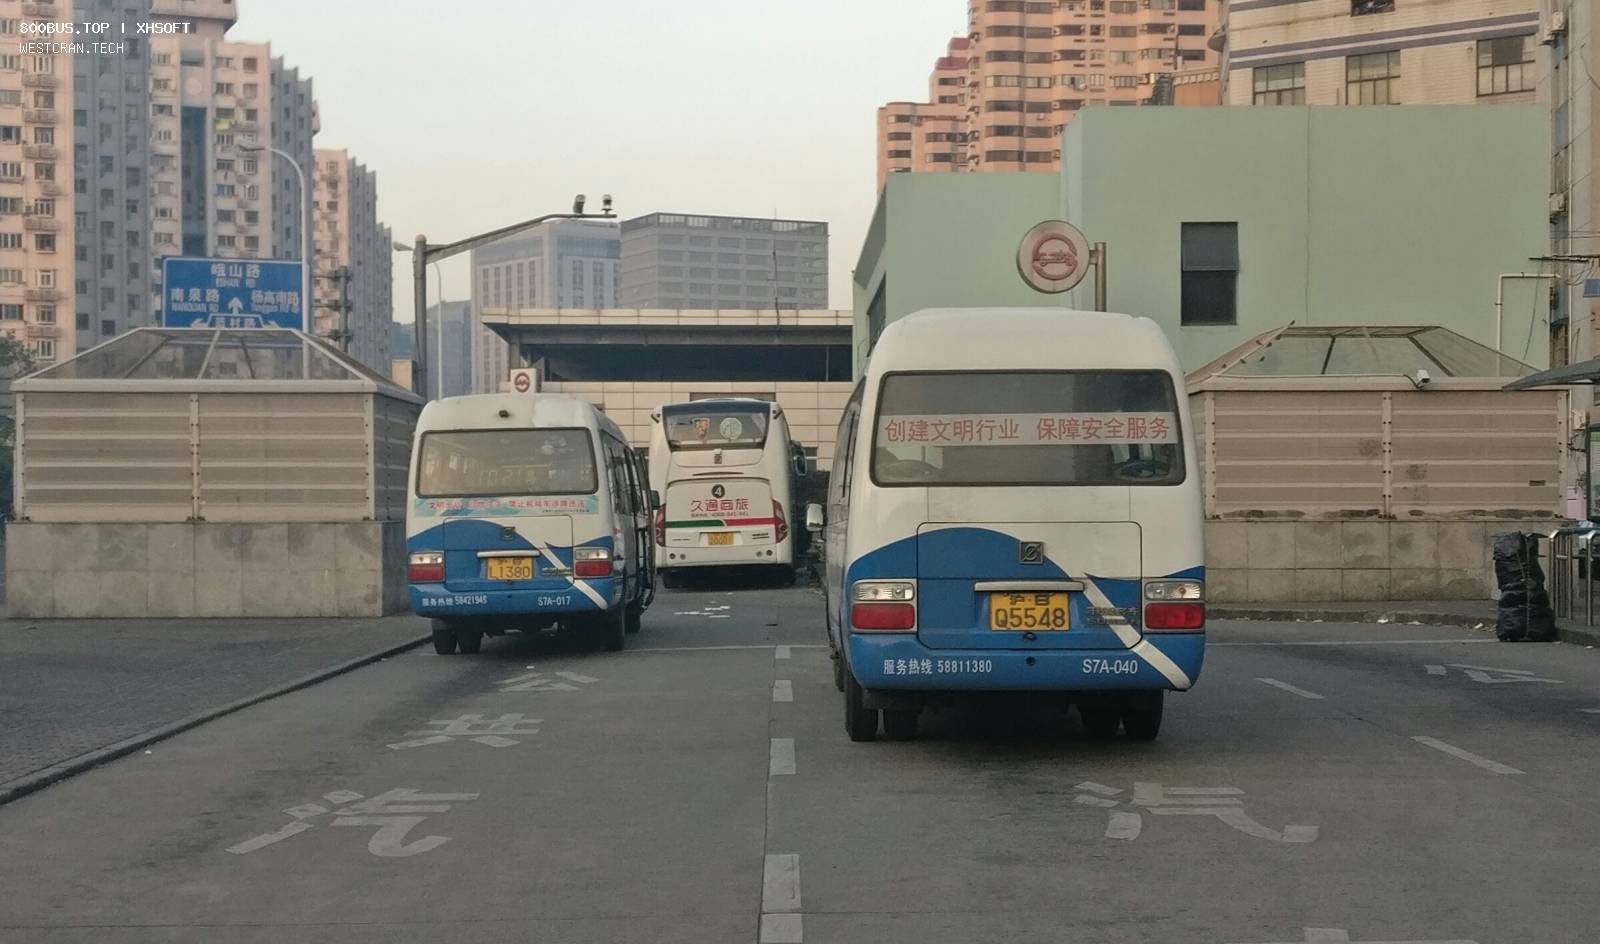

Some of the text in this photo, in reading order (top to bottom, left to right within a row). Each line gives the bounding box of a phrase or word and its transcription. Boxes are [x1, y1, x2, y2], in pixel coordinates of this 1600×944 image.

[884, 416, 1170, 443] 创建文明行业 保障安全服务
[713, 485, 724, 498] 4
[489, 566, 531, 578] L1380
[538, 596, 571, 606] S7A-017
[995, 607, 1066, 628] Q5548
[883, 659, 992, 675] 服务热线 58811380
[1082, 658, 1138, 674] S7A-040
